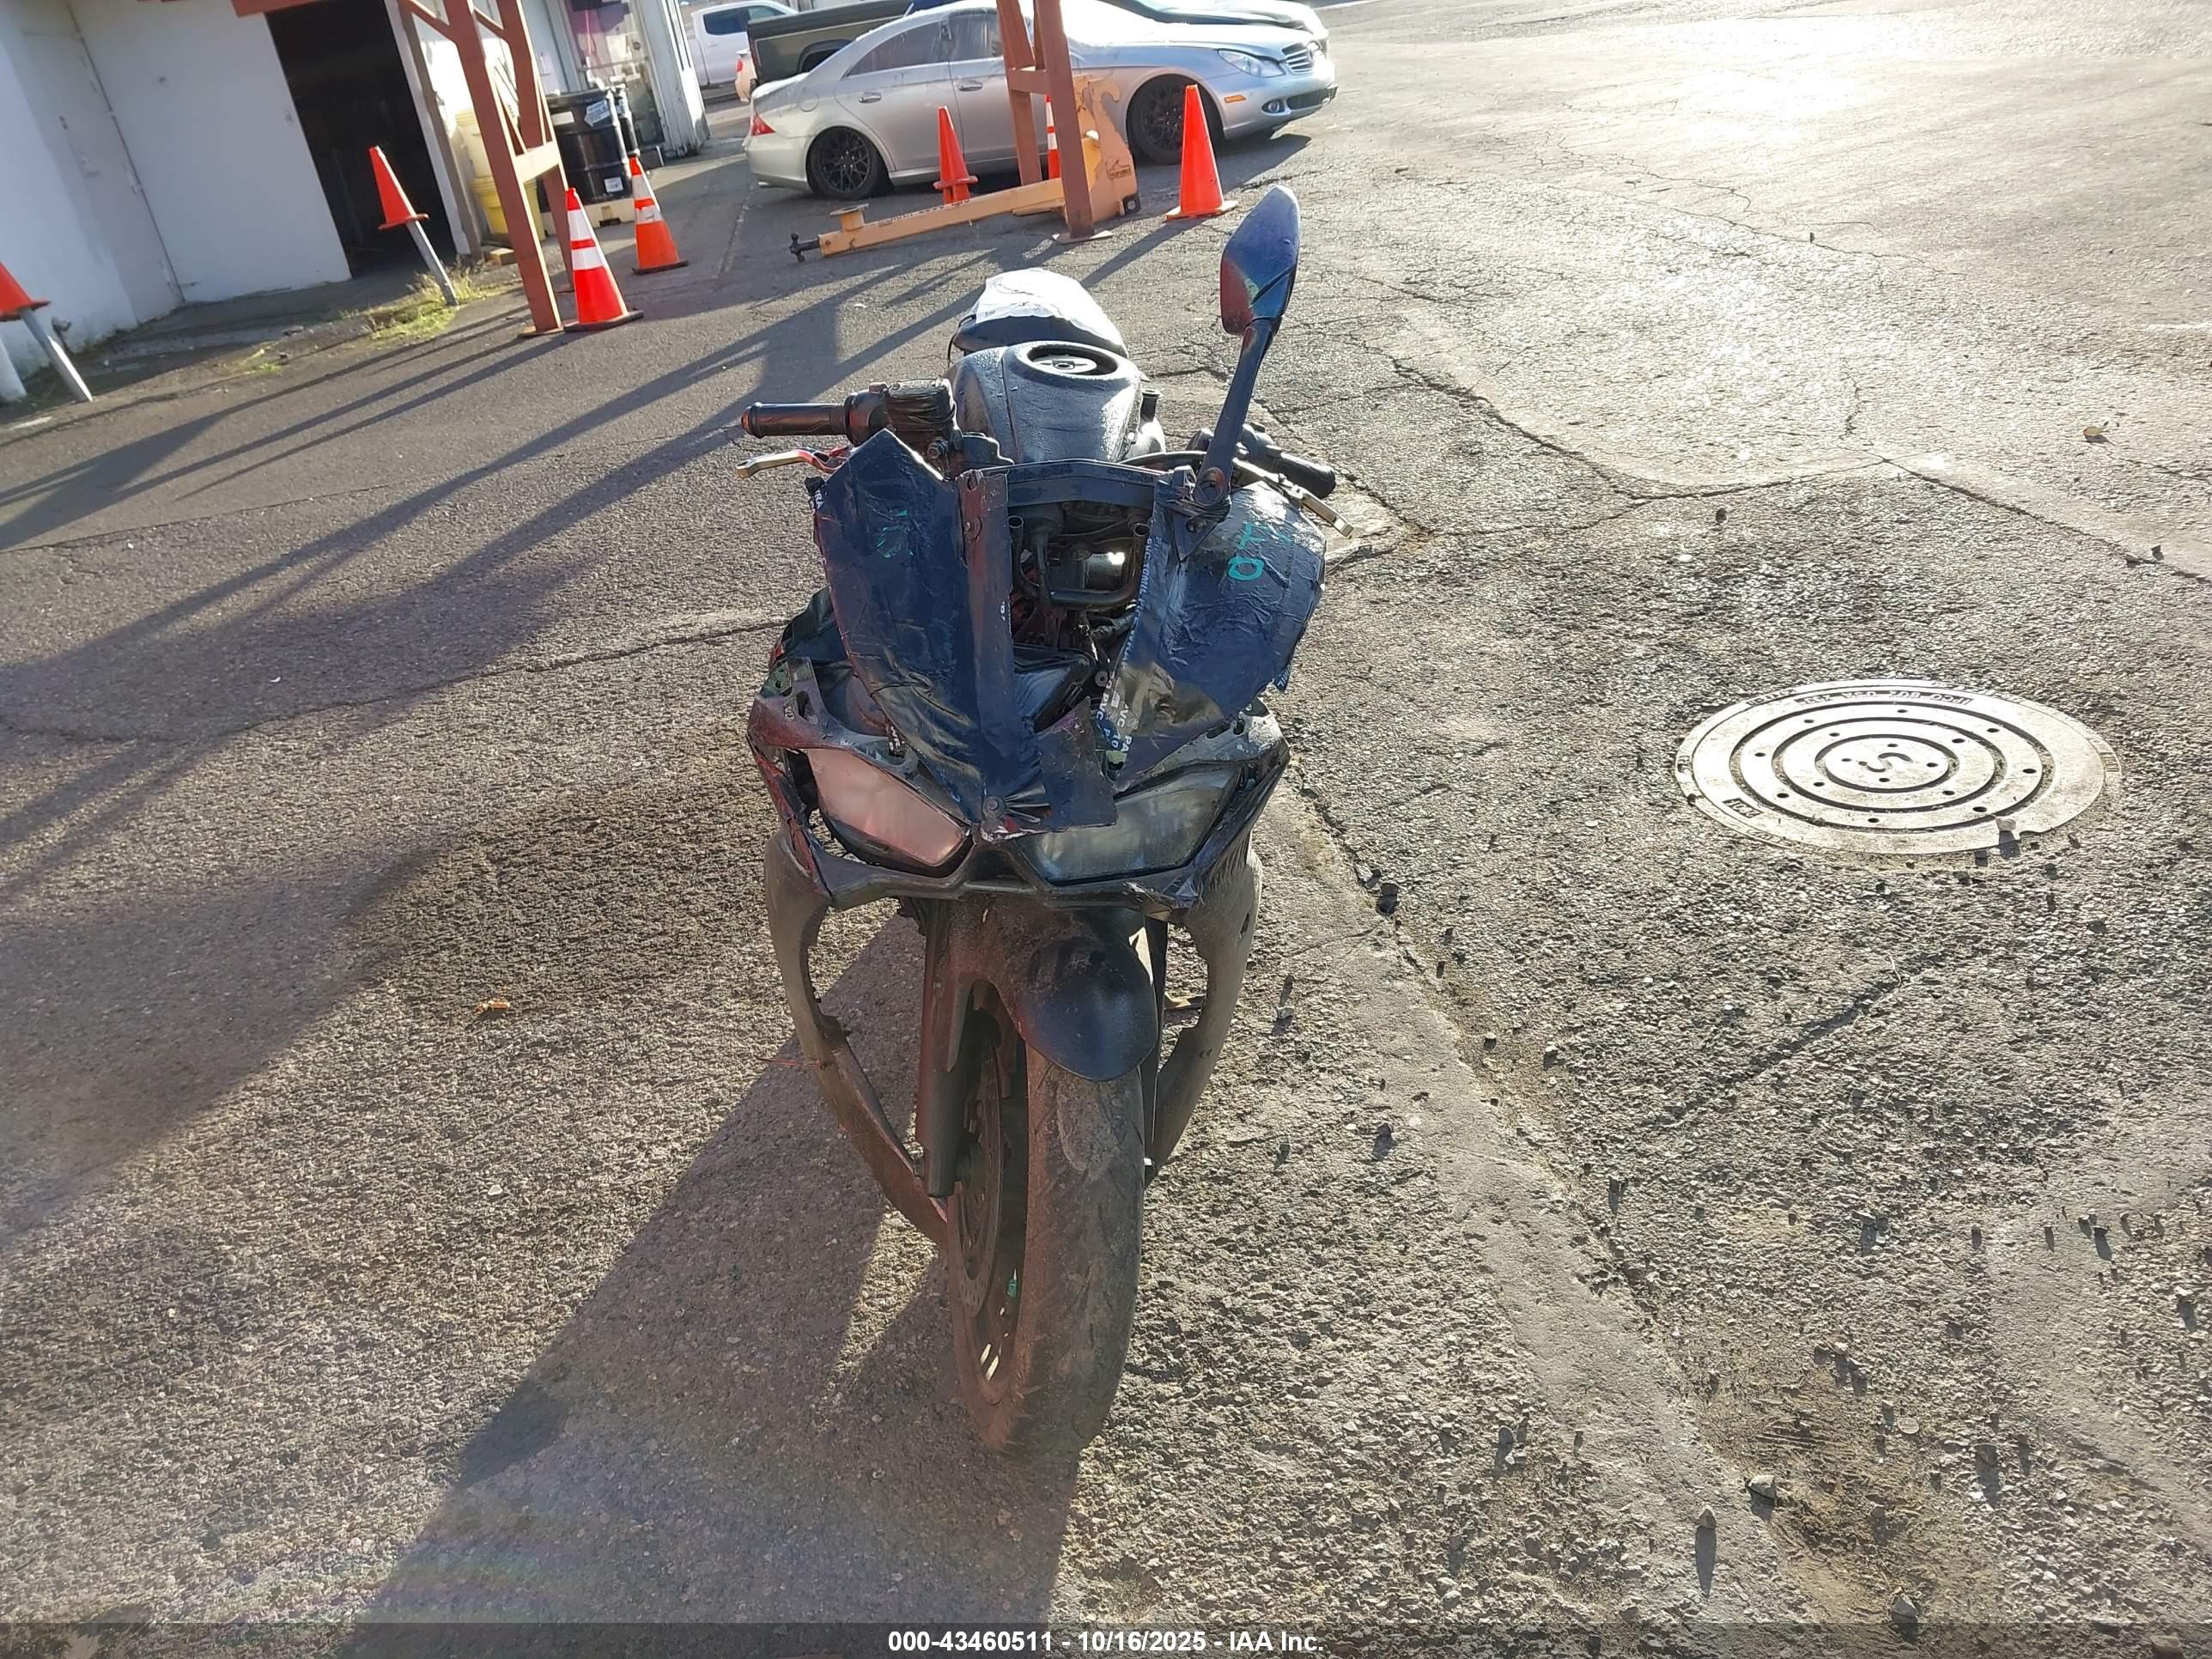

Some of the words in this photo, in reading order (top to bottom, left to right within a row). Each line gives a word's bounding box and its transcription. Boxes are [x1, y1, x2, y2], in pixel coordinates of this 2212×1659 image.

[1841, 691, 1878, 700] USA
[1931, 694, 1973, 705] IPCO
[1096, 693, 1109, 720] PVC
